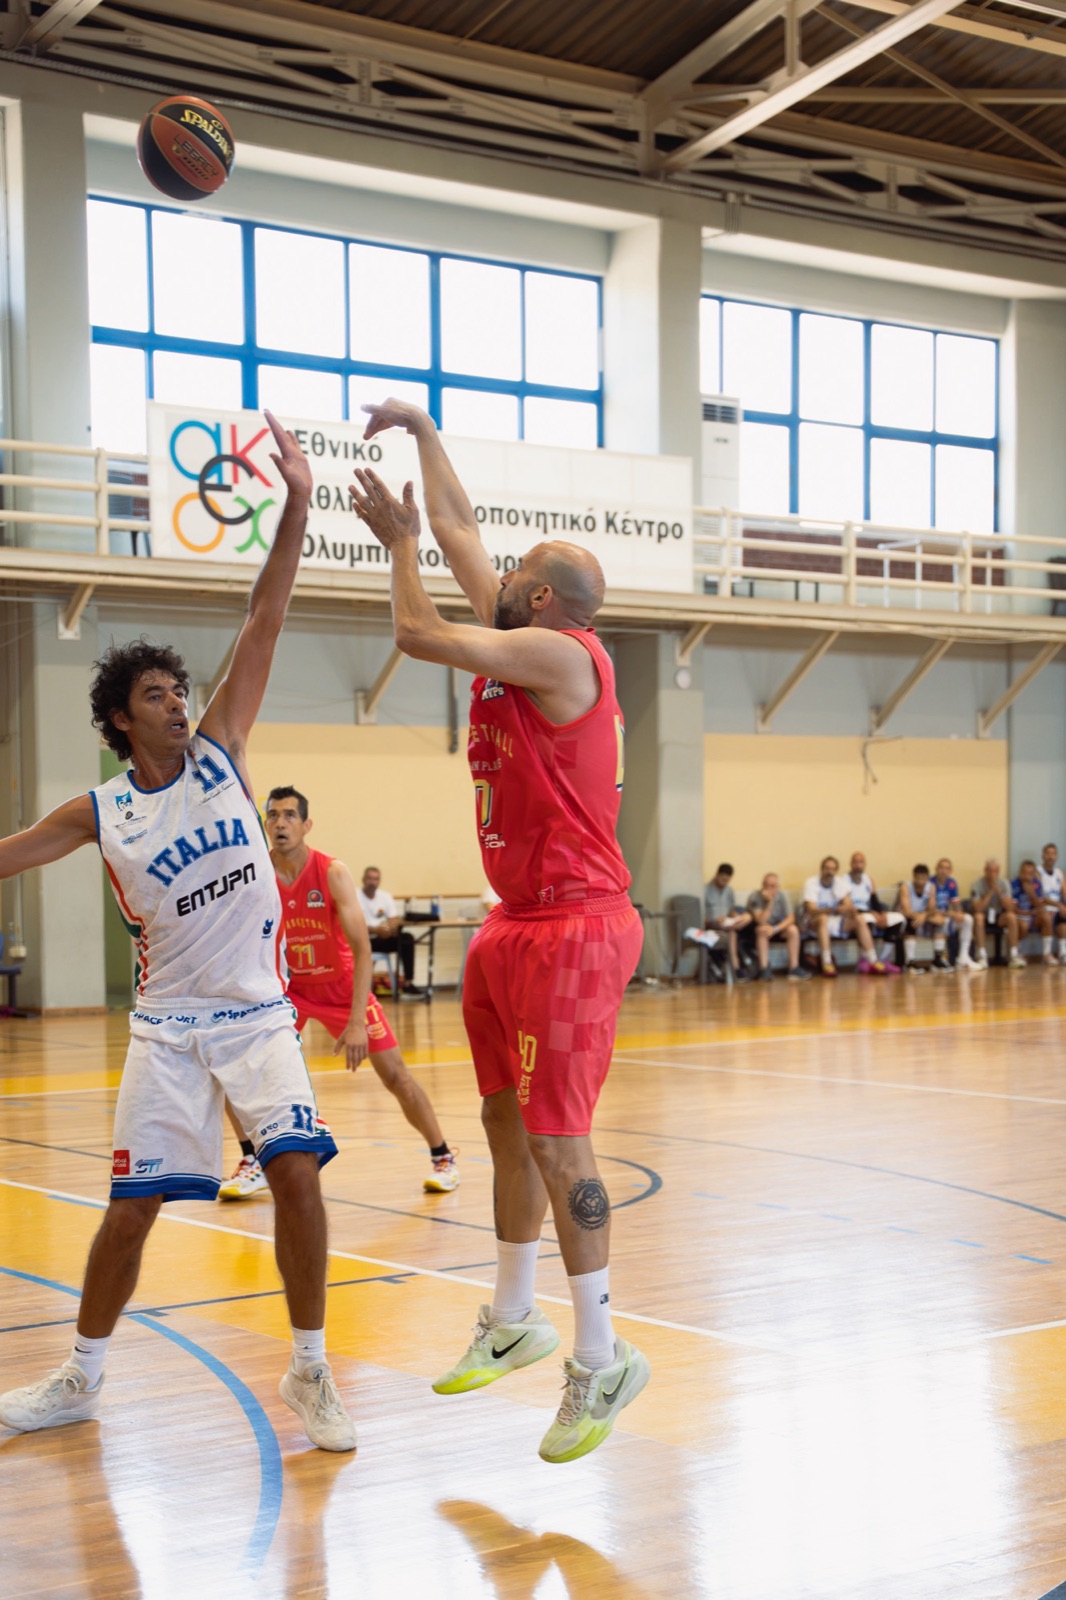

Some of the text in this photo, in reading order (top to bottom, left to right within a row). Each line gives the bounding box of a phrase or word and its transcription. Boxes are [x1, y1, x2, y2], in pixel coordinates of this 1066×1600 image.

[295, 429, 383, 462] Εθνικό
[474, 505, 684, 543] οπονητικό Κέντρο
[192, 754, 229, 794] 11
[146, 818, 250, 888] ITALIA
[286, 917, 332, 937] ASKETBALL
[290, 1104, 314, 1135] 11
